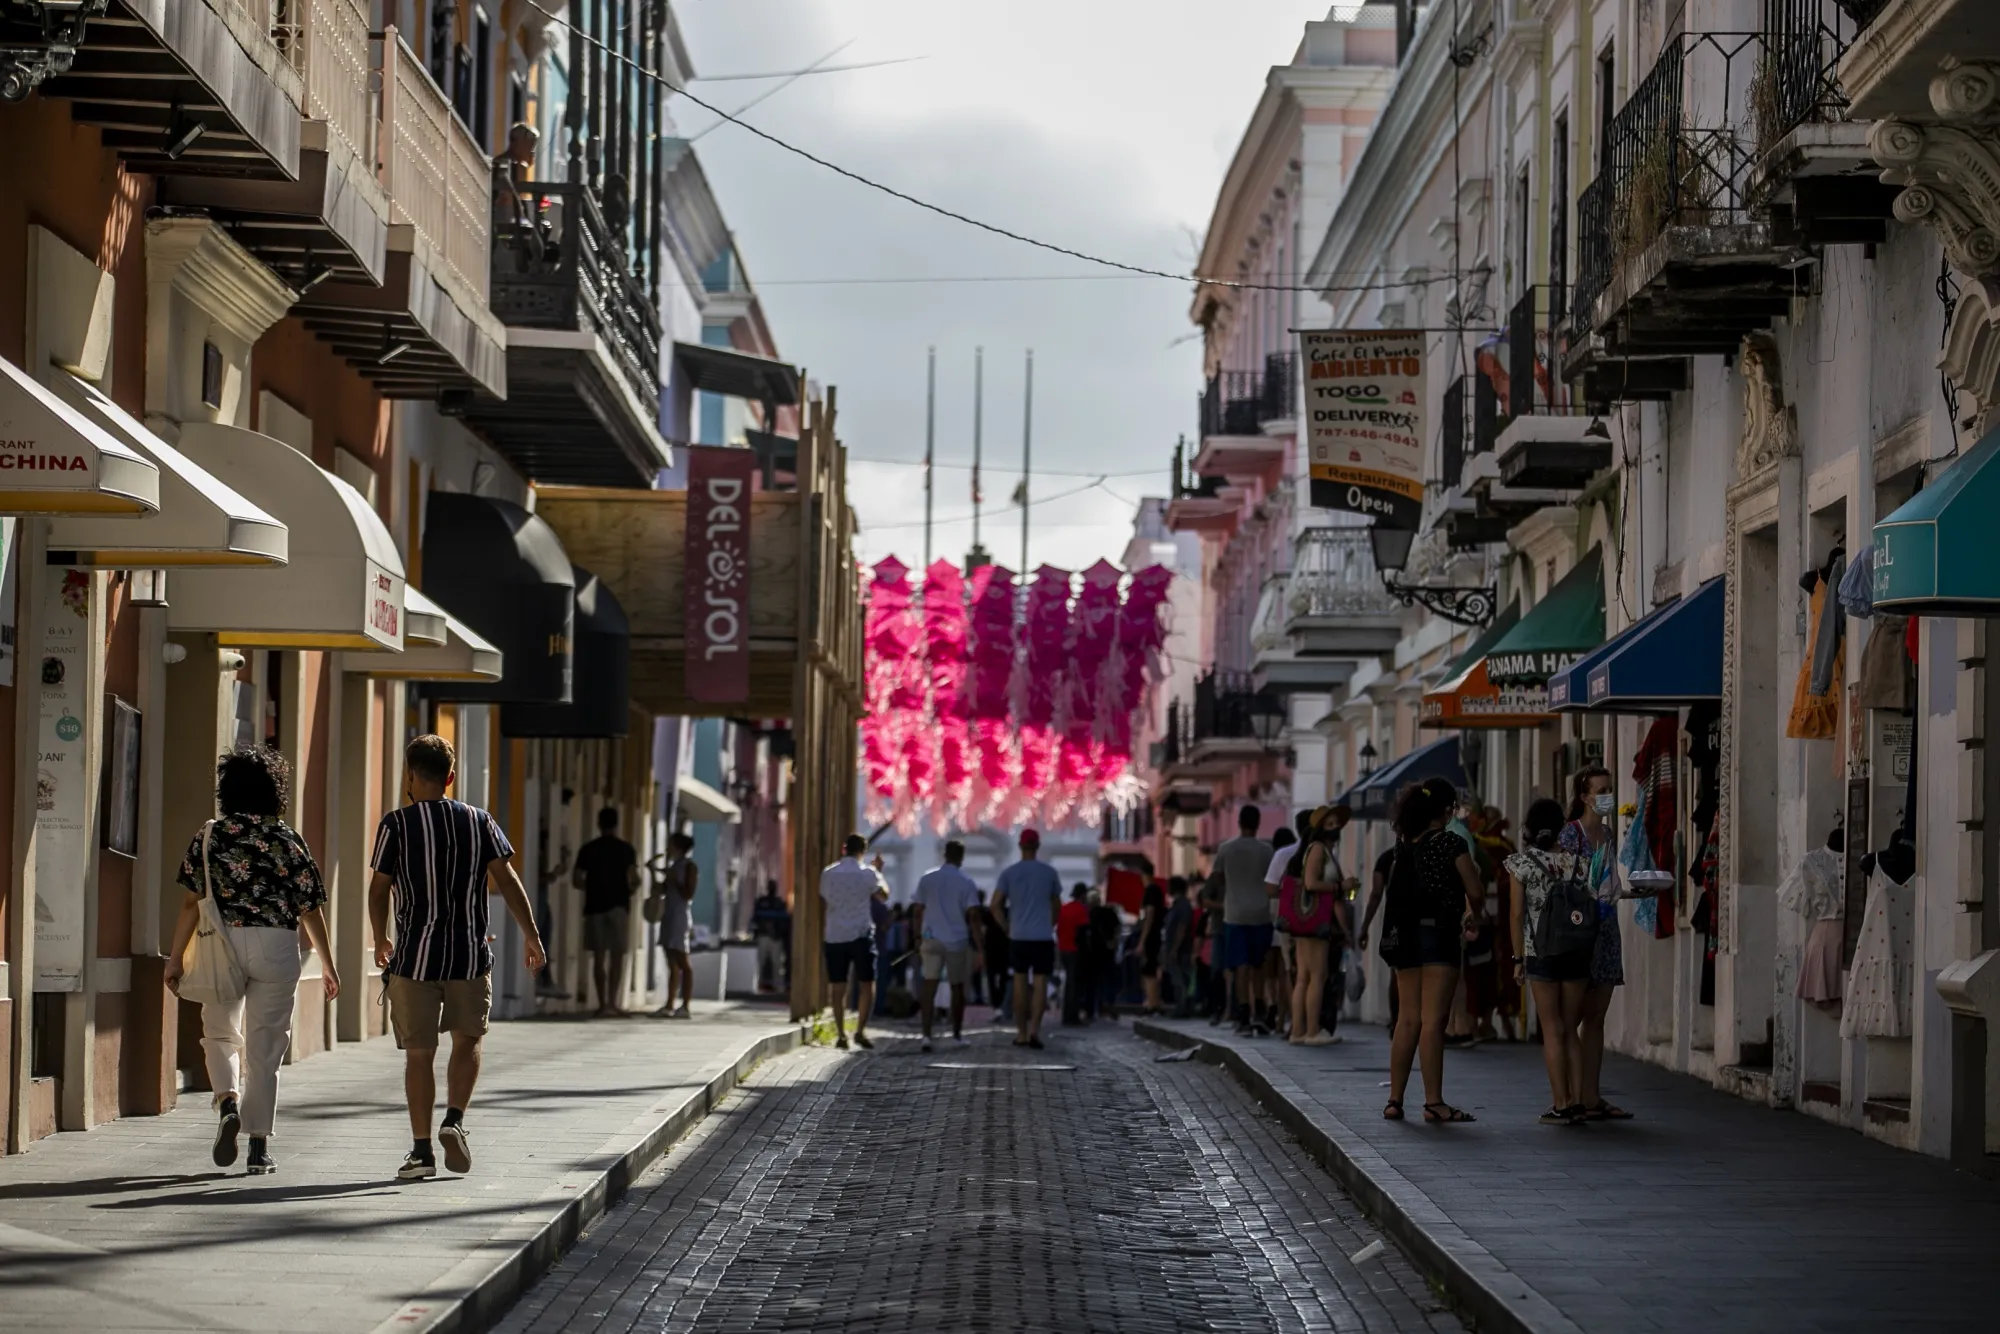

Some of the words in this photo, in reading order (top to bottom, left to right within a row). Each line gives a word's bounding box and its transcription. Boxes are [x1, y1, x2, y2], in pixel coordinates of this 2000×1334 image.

[1307, 332, 1420, 345] Restaurant
[1310, 348, 1347, 361] Café
[1353, 346, 1368, 359] El
[1374, 345, 1420, 359] Punto
[1310, 357, 1420, 380] ABIERTO
[1314, 384, 1381, 399] TOGO
[1314, 410, 1403, 425] DELIVERY
[0, 454, 88, 472] CHINA
[1328, 467, 1411, 494] Restaurant
[706, 477, 744, 541] DEL
[1346, 486, 1394, 515] Open
[48, 626, 74, 636] BAY
[704, 590, 740, 662] SOL
[1486, 655, 1537, 677] PANAMA
